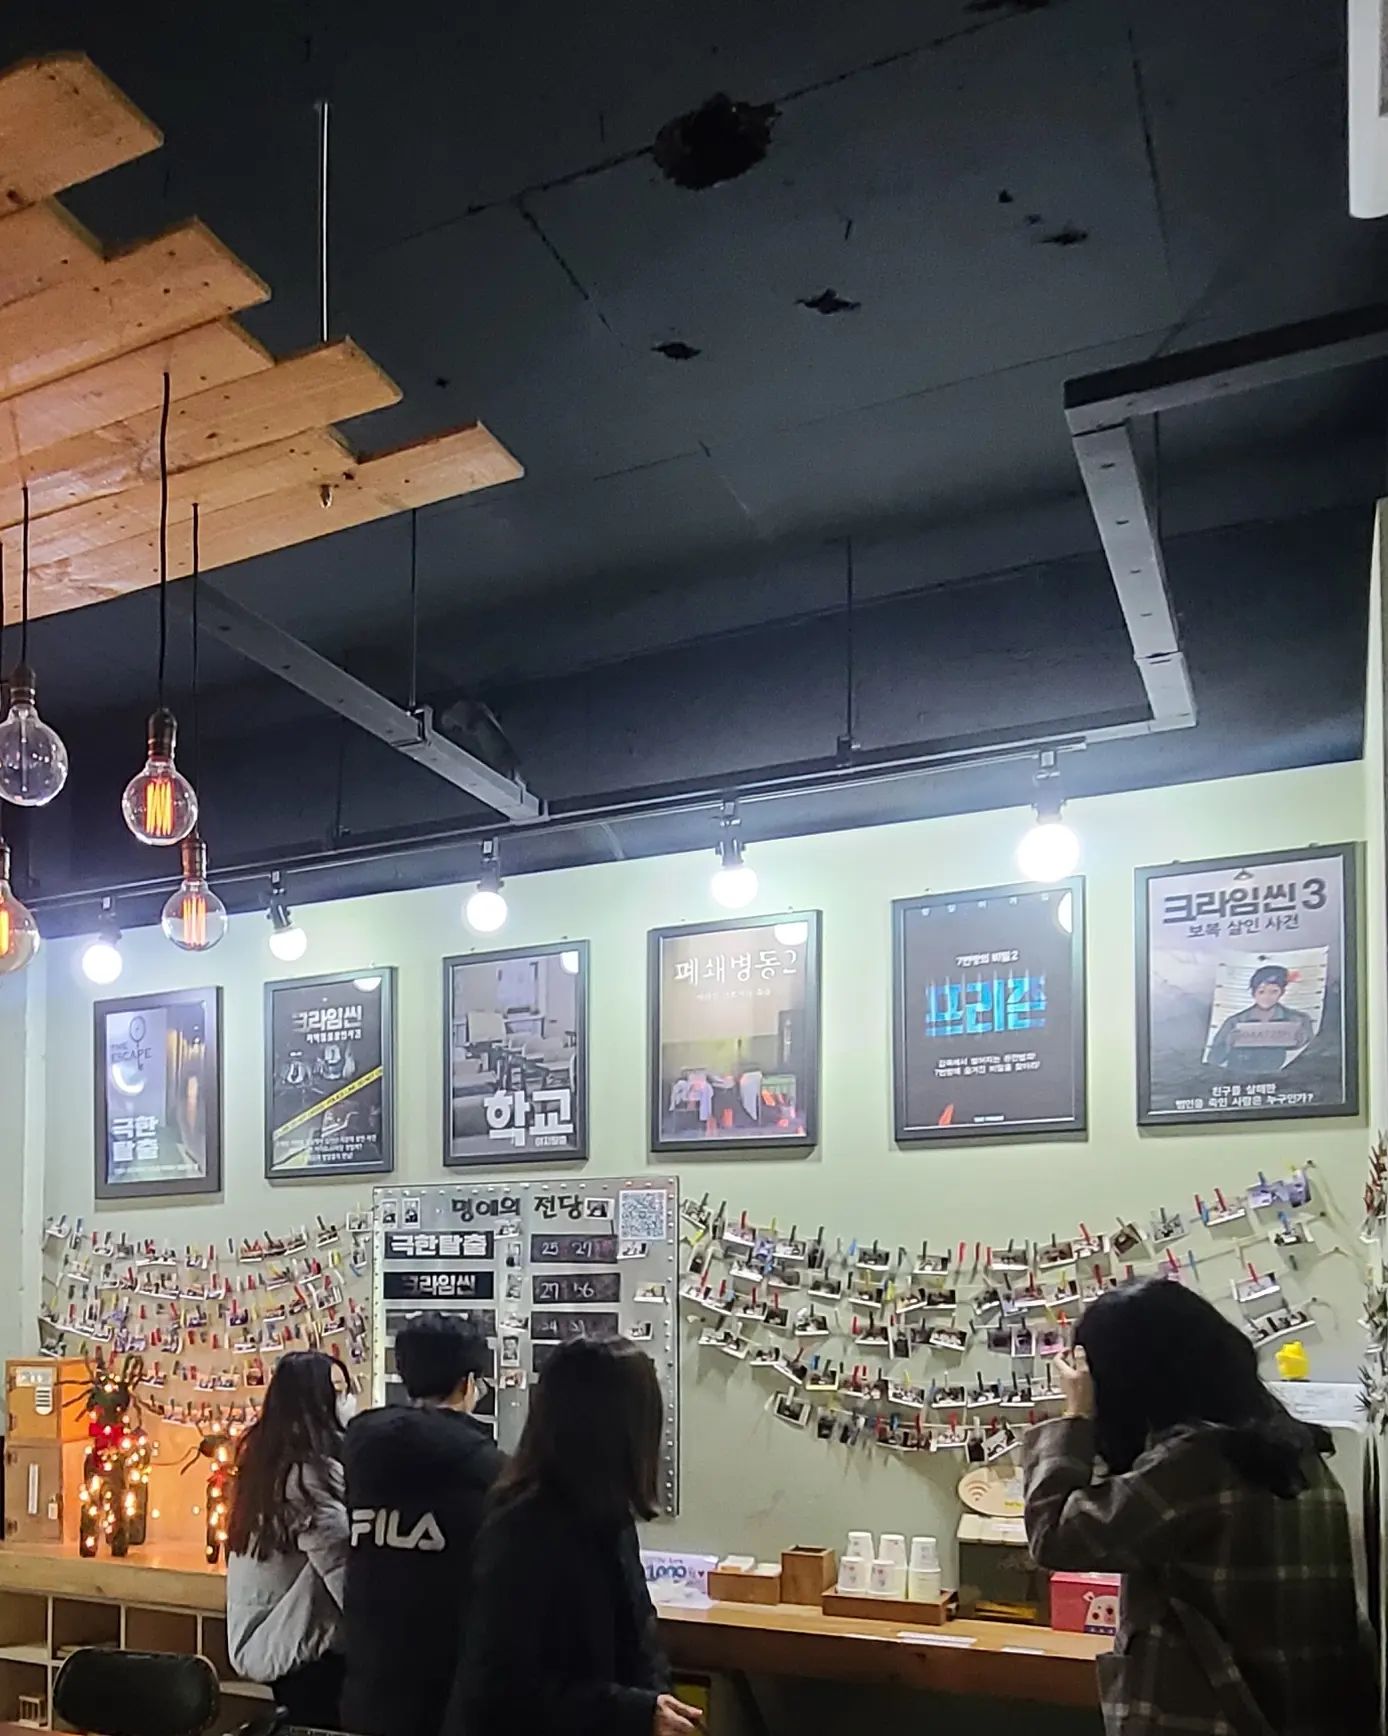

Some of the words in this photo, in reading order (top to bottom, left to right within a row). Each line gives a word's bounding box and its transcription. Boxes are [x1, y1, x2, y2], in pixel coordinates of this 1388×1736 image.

[1227, 918, 1260, 935] 살인
[1265, 914, 1299, 931] 사건
[292, 1005, 362, 1032] 크라임씬
[111, 1115, 158, 1139] 극한
[484, 1088, 574, 1147] 학교
[534, 1194, 583, 1219] 전당
[391, 1234, 487, 1256] 극한탈출
[541, 1241, 559, 1256] 25
[401, 1275, 475, 1296] 크라임씬
[540, 1282, 559, 1300] 27
[350, 1508, 446, 1552] FILA
